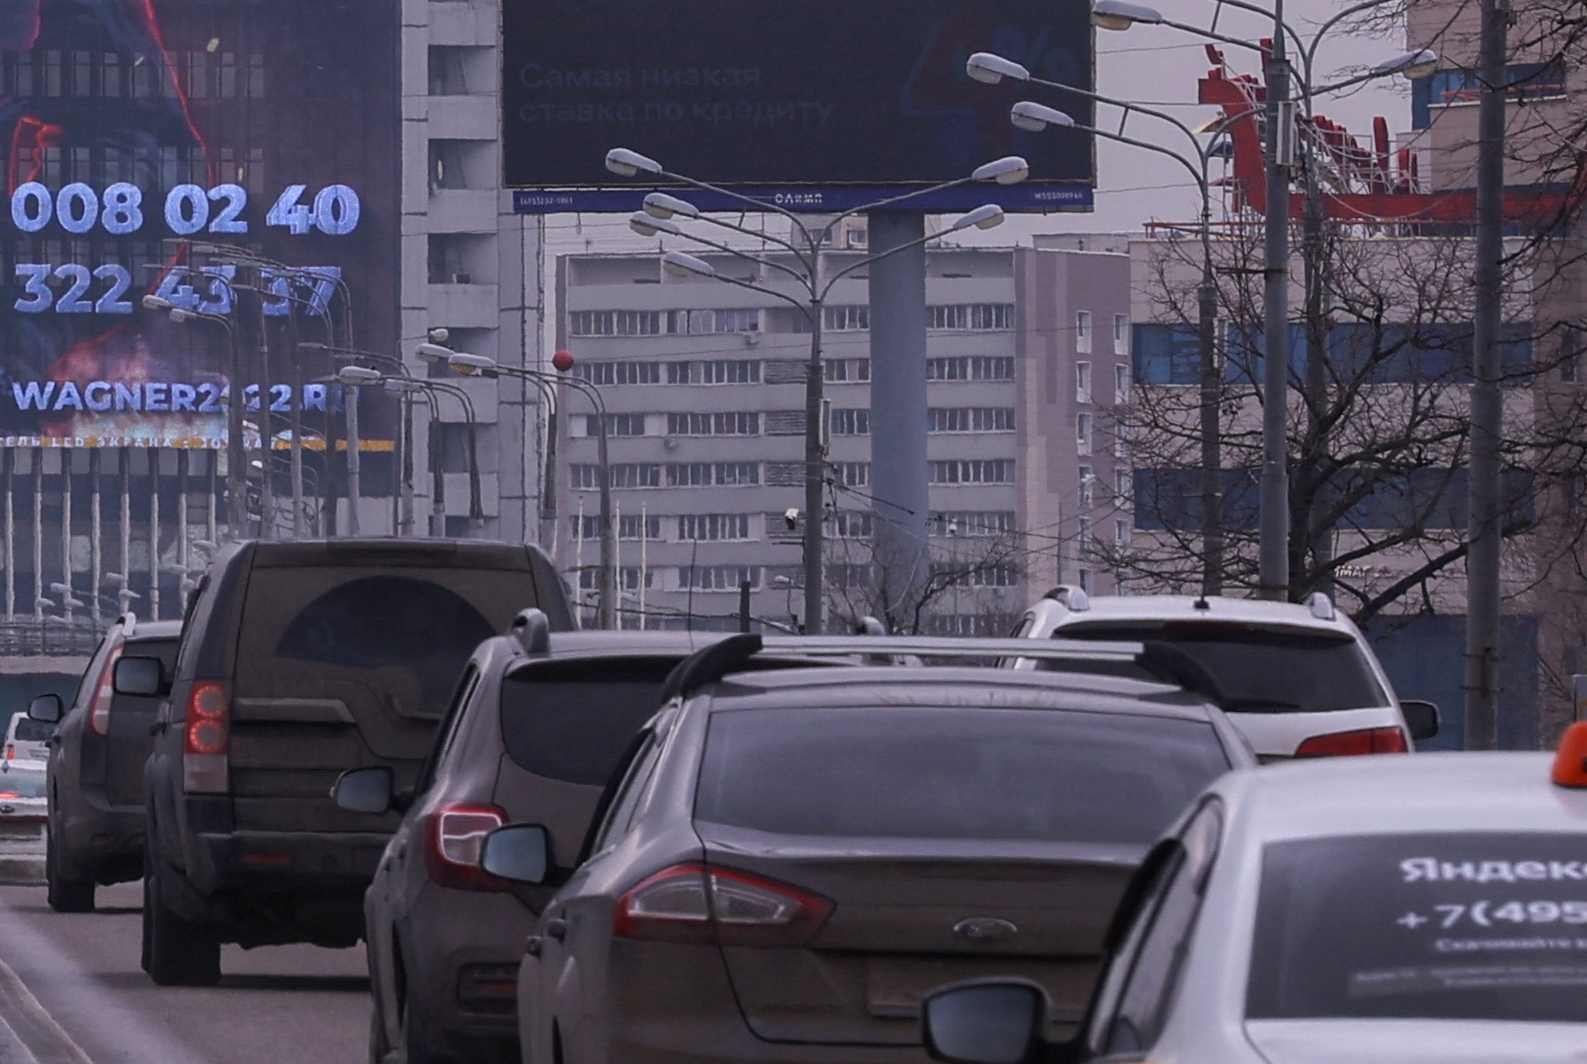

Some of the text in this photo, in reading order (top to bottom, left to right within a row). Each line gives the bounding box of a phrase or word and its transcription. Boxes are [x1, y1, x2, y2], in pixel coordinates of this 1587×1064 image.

[519, 64, 761, 88] Самая низкая
[519, 101, 836, 129] ставка по кредиту
[10, 181, 144, 234] 008
[164, 183, 249, 235] 02
[265, 184, 362, 235] 40
[13, 263, 133, 314] 322
[51, 437, 85, 448] LED
[1399, 857, 1587, 884] Яндек
